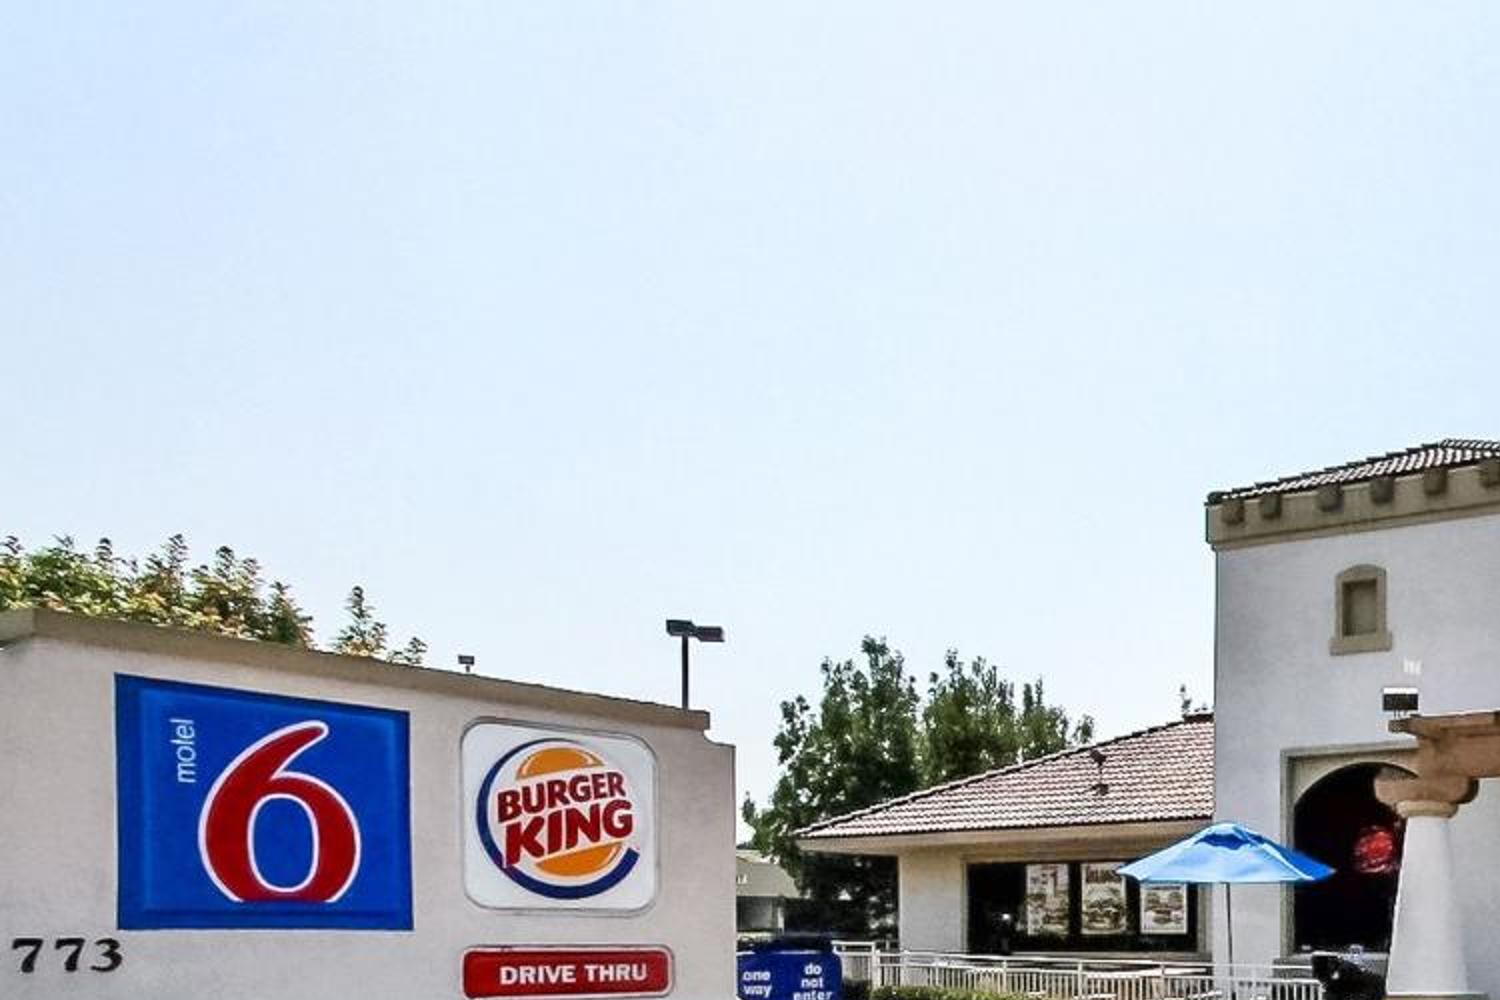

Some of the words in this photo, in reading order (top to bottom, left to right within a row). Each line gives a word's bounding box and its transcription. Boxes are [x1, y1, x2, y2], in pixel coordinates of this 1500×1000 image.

[169, 718, 197, 783] motel
[198, 720, 362, 904] 6
[497, 771, 627, 824] BURGER
[505, 799, 634, 867] KING
[11, 937, 124, 974] 773
[803, 962, 823, 975] do
[500, 965, 577, 985] DRIVE
[583, 962, 648, 982] THRU
[742, 969, 771, 981] one
[801, 977, 824, 990] not
[743, 984, 772, 998] way
